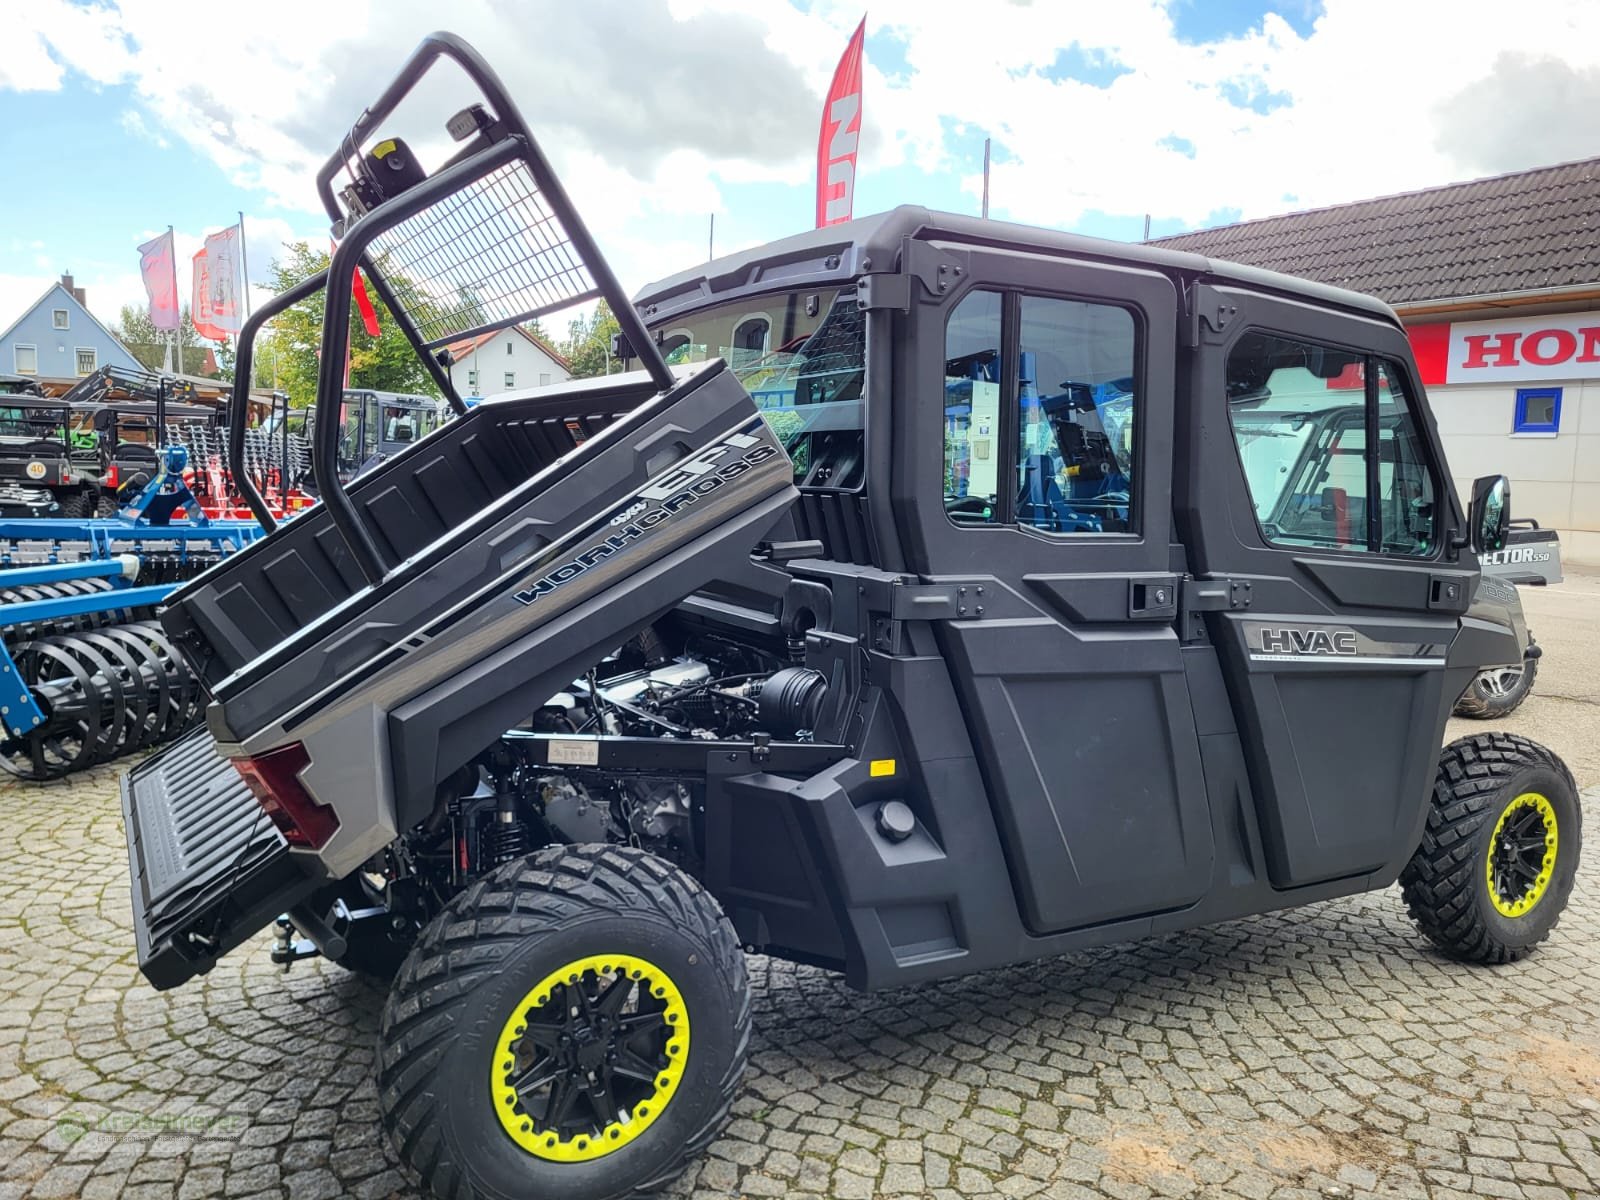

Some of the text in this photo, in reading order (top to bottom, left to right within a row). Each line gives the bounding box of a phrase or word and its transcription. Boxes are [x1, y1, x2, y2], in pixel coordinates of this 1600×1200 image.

[638, 433, 761, 501] EFI
[1477, 548, 1534, 566] ECTOR
[1260, 627, 1357, 655] HVAC
